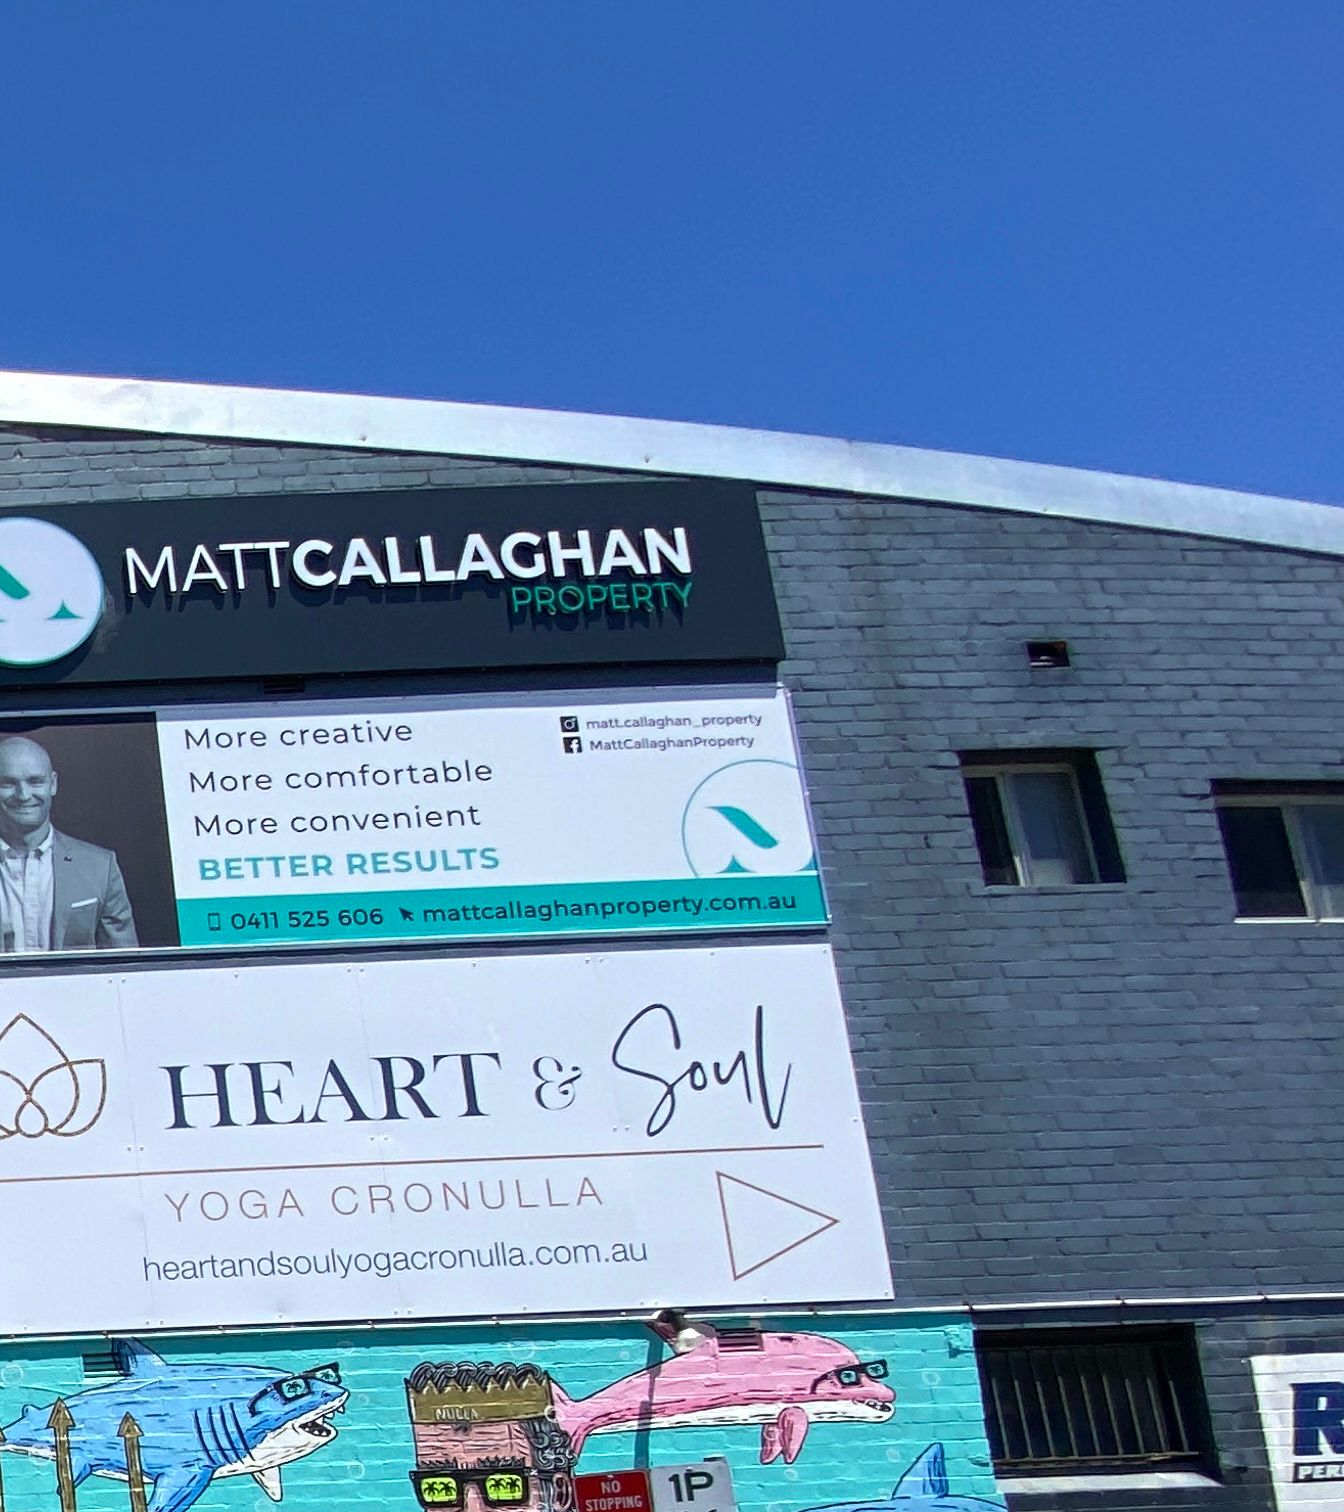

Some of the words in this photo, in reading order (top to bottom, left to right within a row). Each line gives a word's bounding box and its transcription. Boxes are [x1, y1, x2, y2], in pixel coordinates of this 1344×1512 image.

[511, 582, 694, 615] PROPERTY
[184, 727, 268, 750] More
[279, 720, 413, 746] creative
[589, 735, 755, 752] MattCallaghanProperty
[189, 771, 273, 793] More
[285, 759, 493, 790] comfortable
[194, 814, 279, 837] More
[290, 805, 482, 833] convenient
[198, 854, 334, 881] BETTER
[345, 847, 501, 875] RESULTS
[231, 911, 279, 930] 0411
[288, 909, 330, 928] 525
[338, 907, 384, 927] 606
[422, 894, 797, 922] mattcallaghanproperty.com.au
[158, 1051, 501, 1130] HEART
[532, 1056, 582, 1111] &
[611, 1003, 792, 1137] Soul
[164, 1188, 305, 1223] YOGA
[330, 1176, 605, 1217] CRONULLA
[142, 1238, 648, 1283] heartandsoulyogacronulla.com.au
[600, 1480, 621, 1494] NO
[668, 1470, 714, 1503] 1P
[585, 1495, 643, 1512] STOPPING
